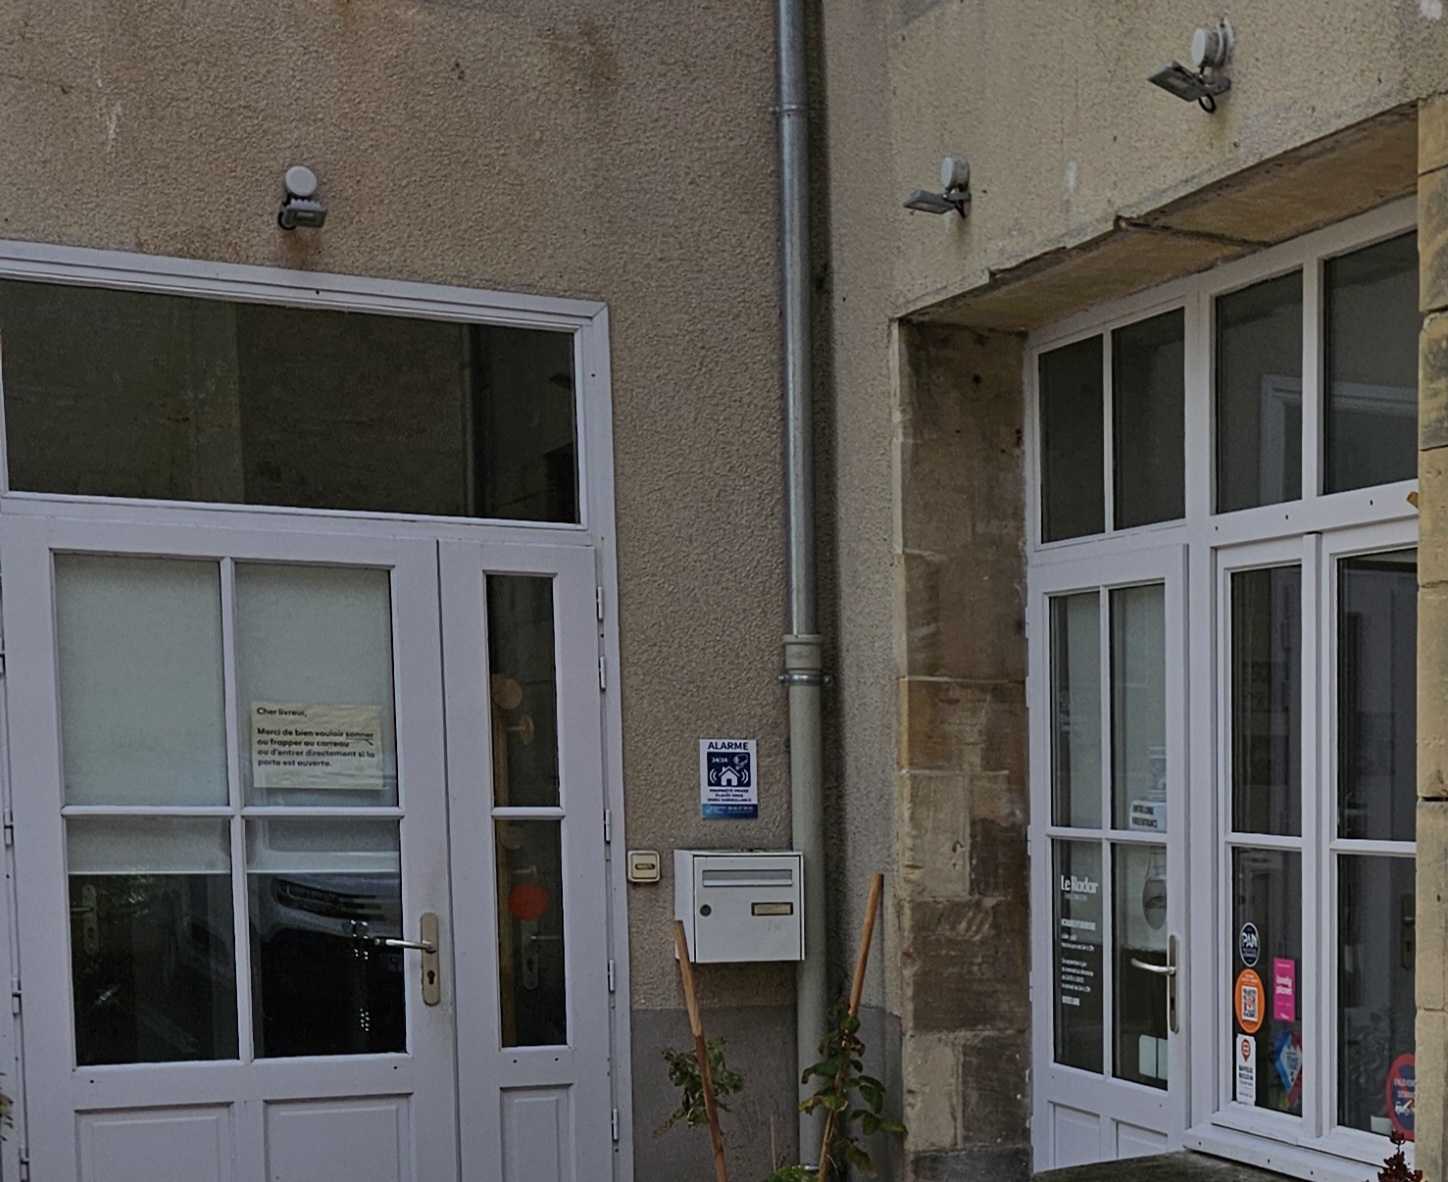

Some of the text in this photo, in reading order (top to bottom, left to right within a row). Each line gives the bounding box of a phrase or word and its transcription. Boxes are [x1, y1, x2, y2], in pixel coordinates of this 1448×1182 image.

[257, 707, 307, 717] Cher livreur,
[257, 728, 280, 736] Merci
[282, 728, 292, 736] de
[270, 739, 302, 747] frapper
[708, 742, 748, 750] ALARME
[1061, 875, 1098, 893] Le Radar
